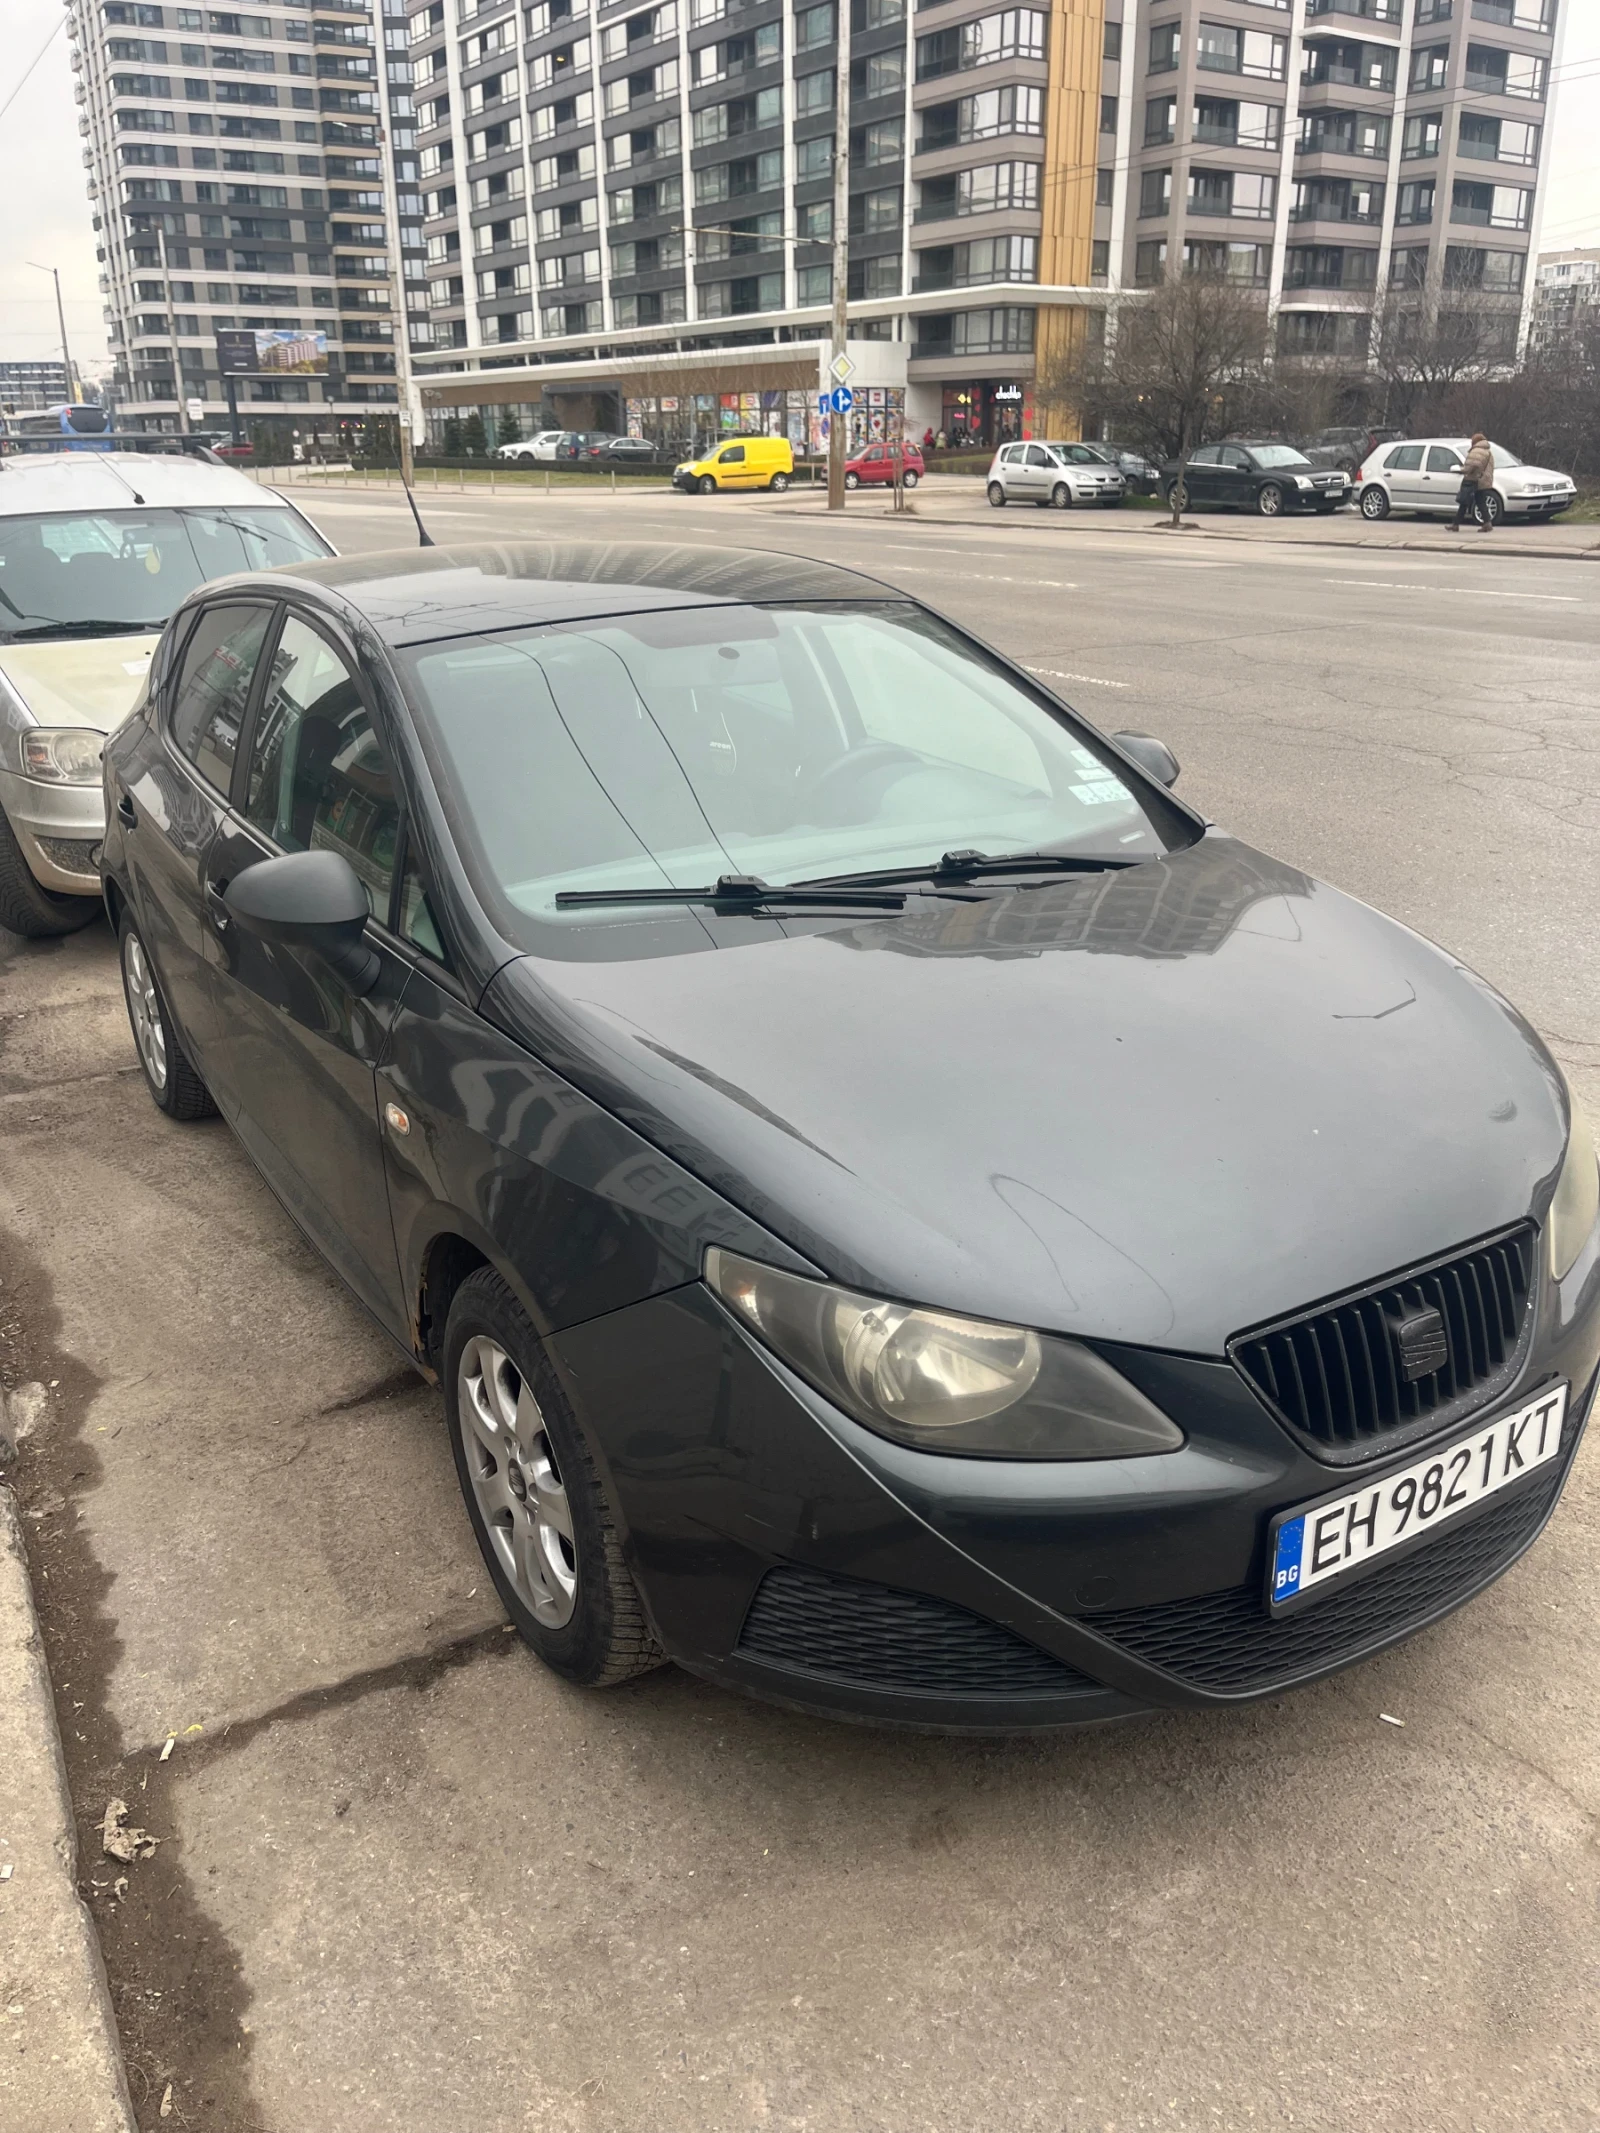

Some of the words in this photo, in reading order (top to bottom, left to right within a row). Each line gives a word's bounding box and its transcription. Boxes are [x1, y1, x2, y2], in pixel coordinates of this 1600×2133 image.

[709, 741, 732, 750] areon
[1311, 1492, 1380, 1574] EH
[1391, 1433, 1495, 1536] 9821
[1503, 1399, 1558, 1476] KT
[1276, 1565, 1299, 1589] BG
